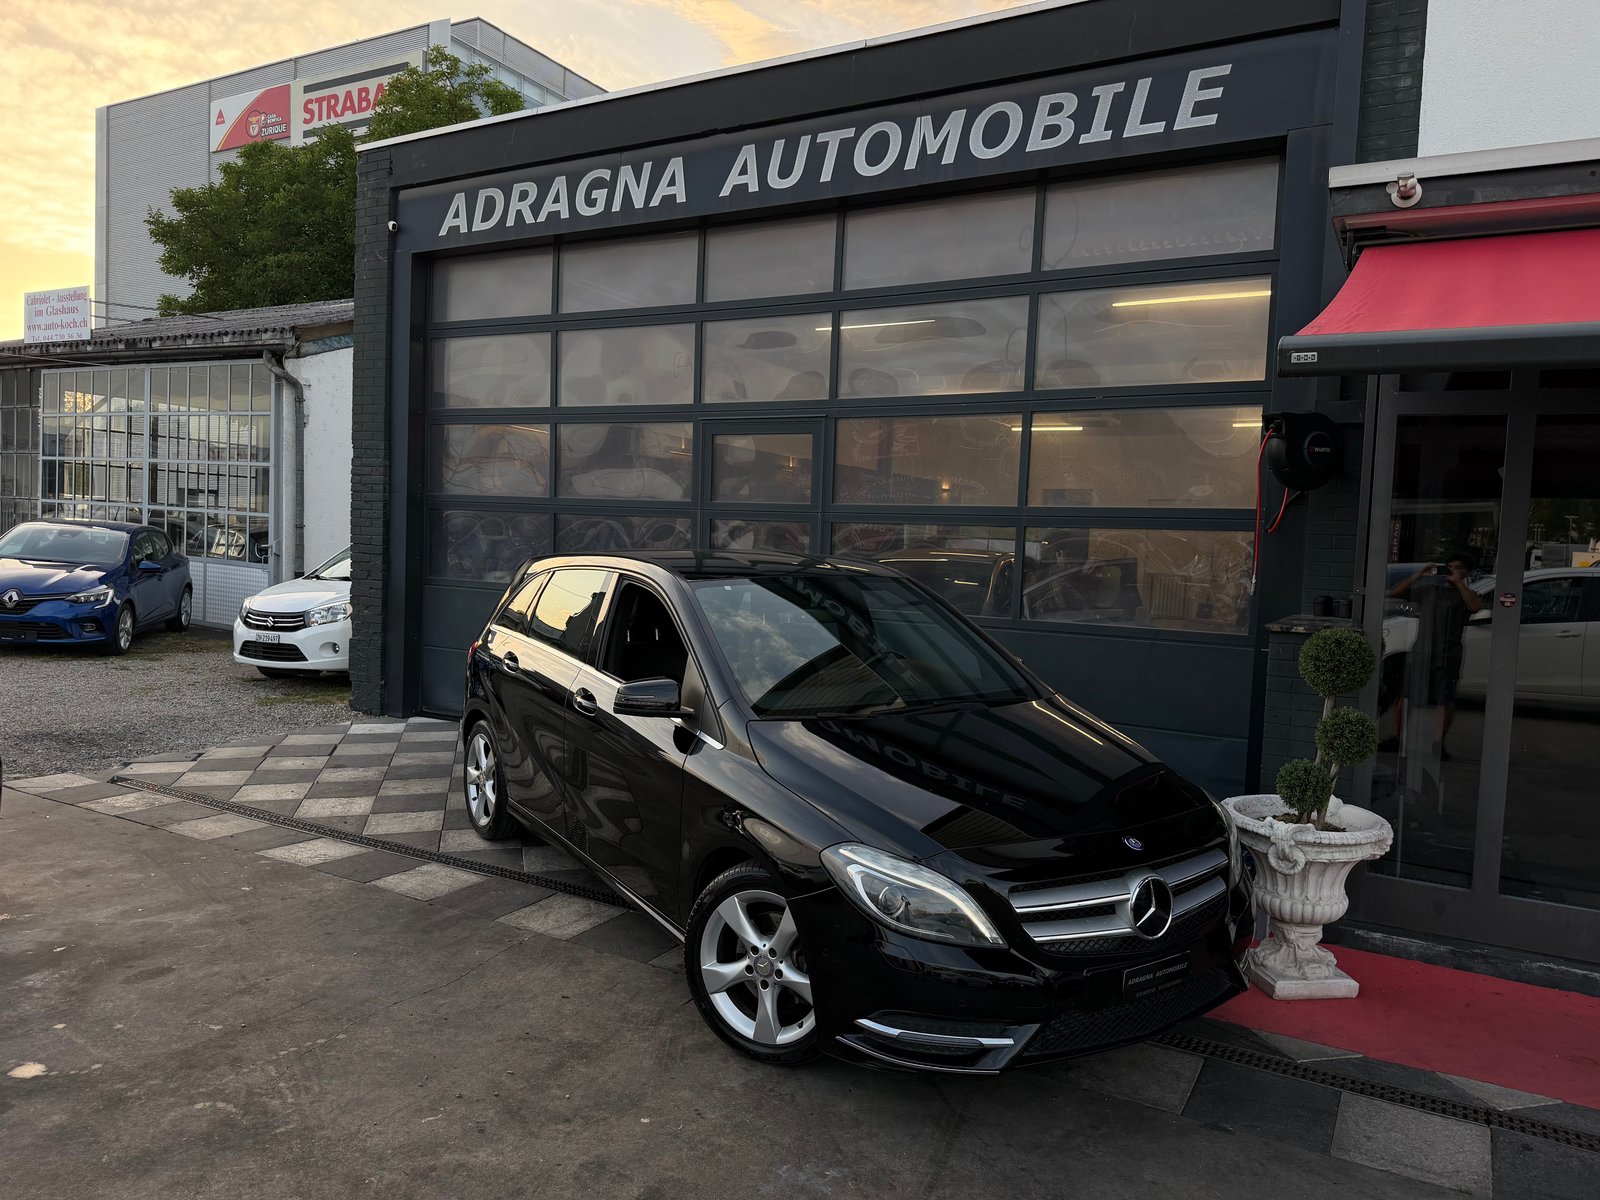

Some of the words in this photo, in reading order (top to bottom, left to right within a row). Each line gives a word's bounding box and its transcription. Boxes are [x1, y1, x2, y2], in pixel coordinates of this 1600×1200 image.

[438, 156, 687, 237] ADRAGNA
[719, 63, 1233, 197] AUTOMOBILE
[34, 307, 43, 318] im
[45, 304, 79, 316] Glashaus
[27, 318, 88, 332] www.auto-koch.ch
